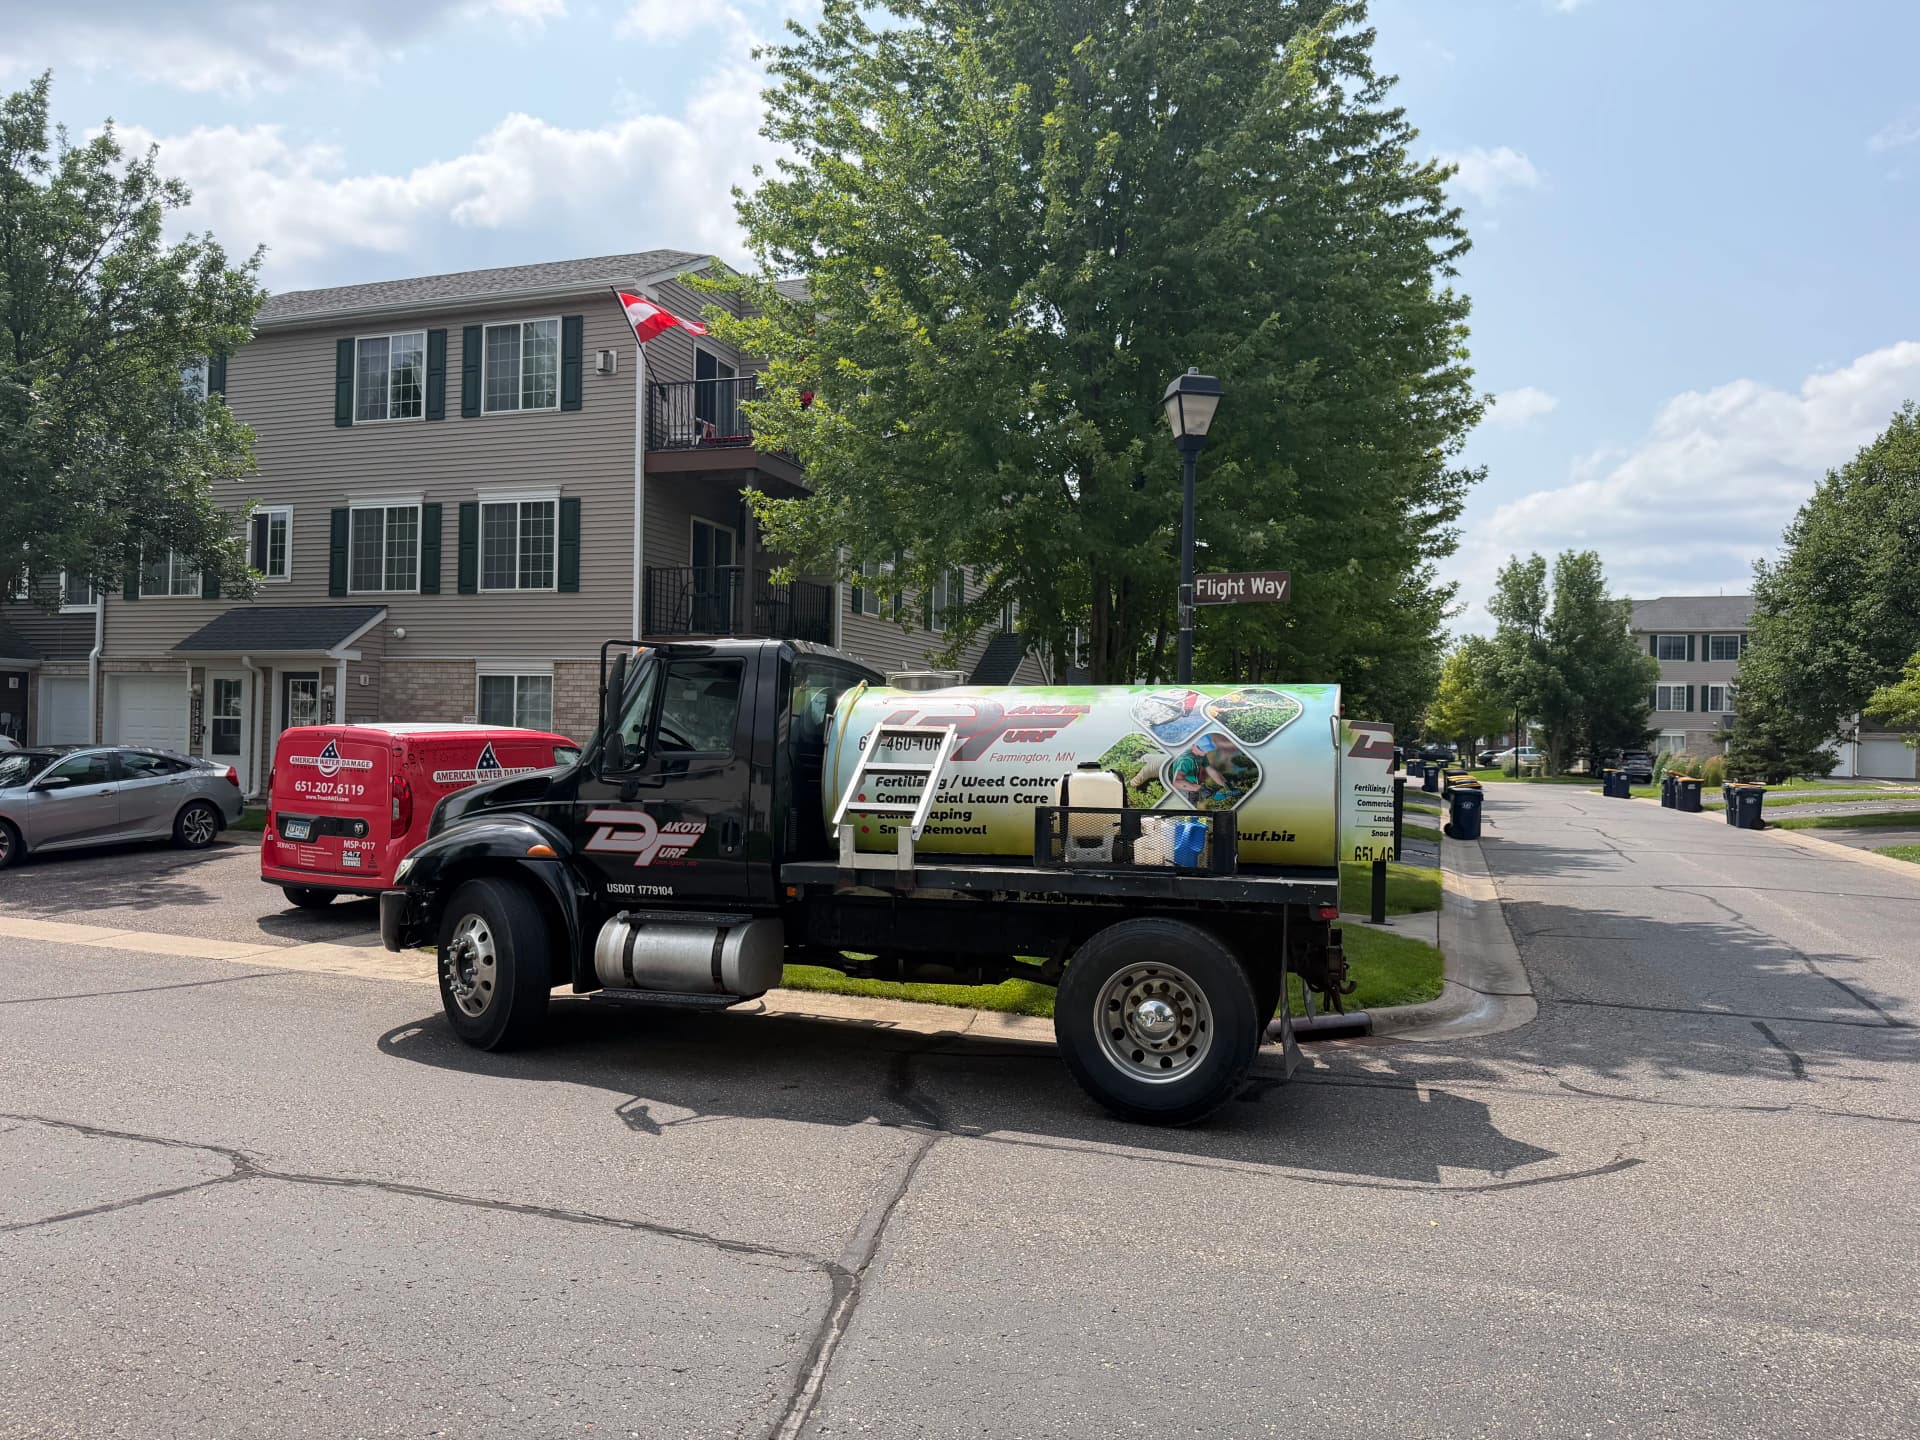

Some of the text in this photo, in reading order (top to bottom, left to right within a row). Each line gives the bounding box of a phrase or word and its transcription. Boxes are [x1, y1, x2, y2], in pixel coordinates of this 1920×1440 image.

[1196, 577, 1287, 600] Flight Way
[859, 736, 944, 751] 6-460-TUR
[291, 756, 371, 768] AMERICAN WATER DAMAGE
[989, 751, 1076, 764] Farmington, MN
[436, 770, 476, 781] AMERICAN
[477, 769, 502, 779] WATER
[876, 775, 947, 789] Fertilizig
[962, 776, 1006, 787] Weed
[1010, 776, 1060, 787] Contro
[294, 781, 365, 796] 651.207.6119
[1354, 784, 1387, 794] Fertilizing
[876, 792, 1049, 804] Commcial Lawn Care
[923, 825, 987, 835] Removal
[277, 841, 296, 850] SERVICES
[343, 840, 376, 851] MSP-017
[342, 850, 361, 858] 24/7
[606, 883, 674, 896] USDOT 1779104
